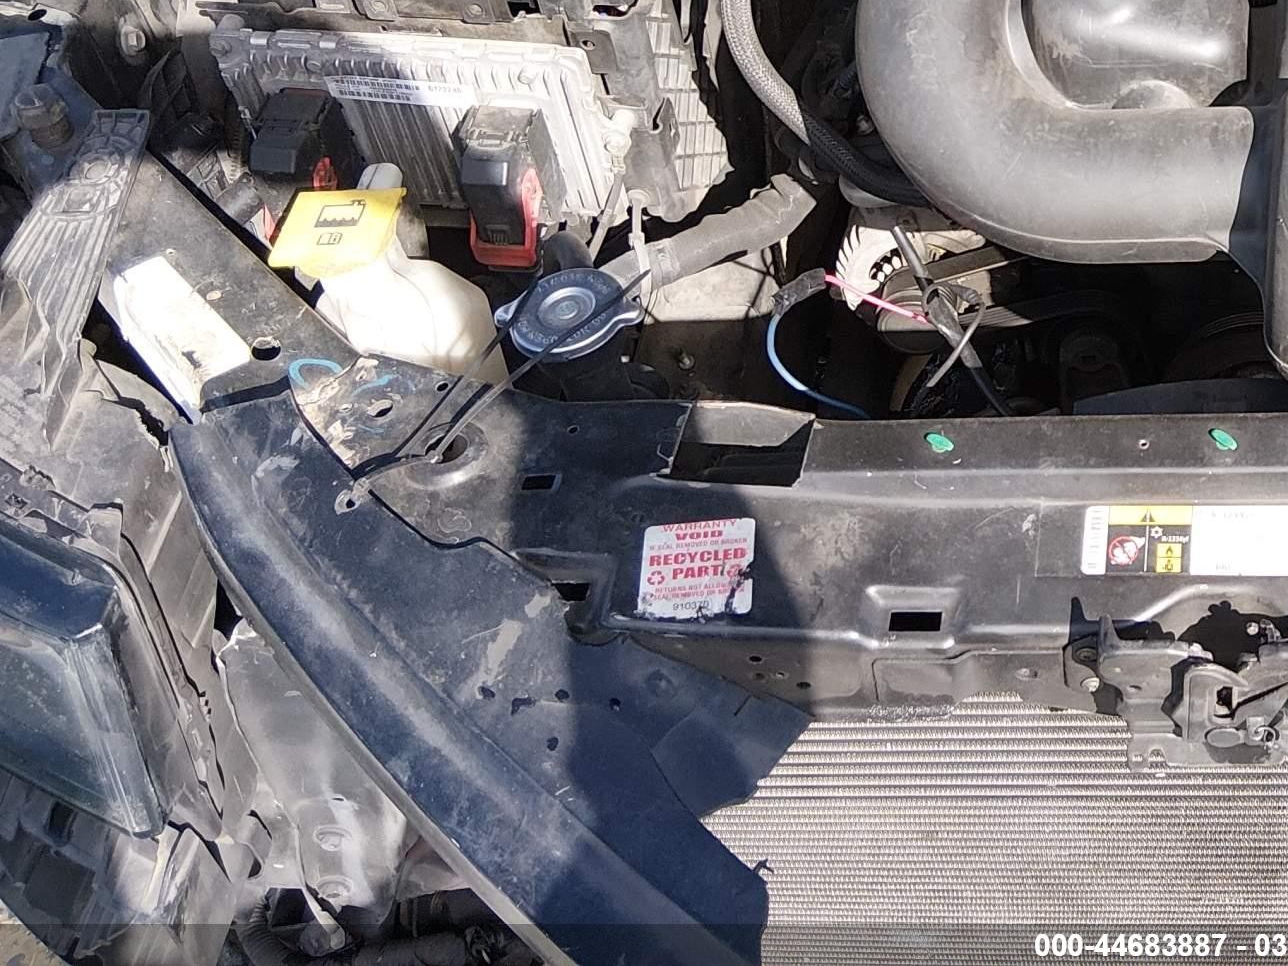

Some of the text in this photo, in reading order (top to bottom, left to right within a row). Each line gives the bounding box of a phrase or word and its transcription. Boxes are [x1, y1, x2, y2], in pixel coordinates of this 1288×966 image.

[663, 519, 737, 533] WARRANTY
[675, 530, 724, 541] VOID
[676, 541, 708, 549] REMOVED
[649, 547, 747, 567] RECYCLED
